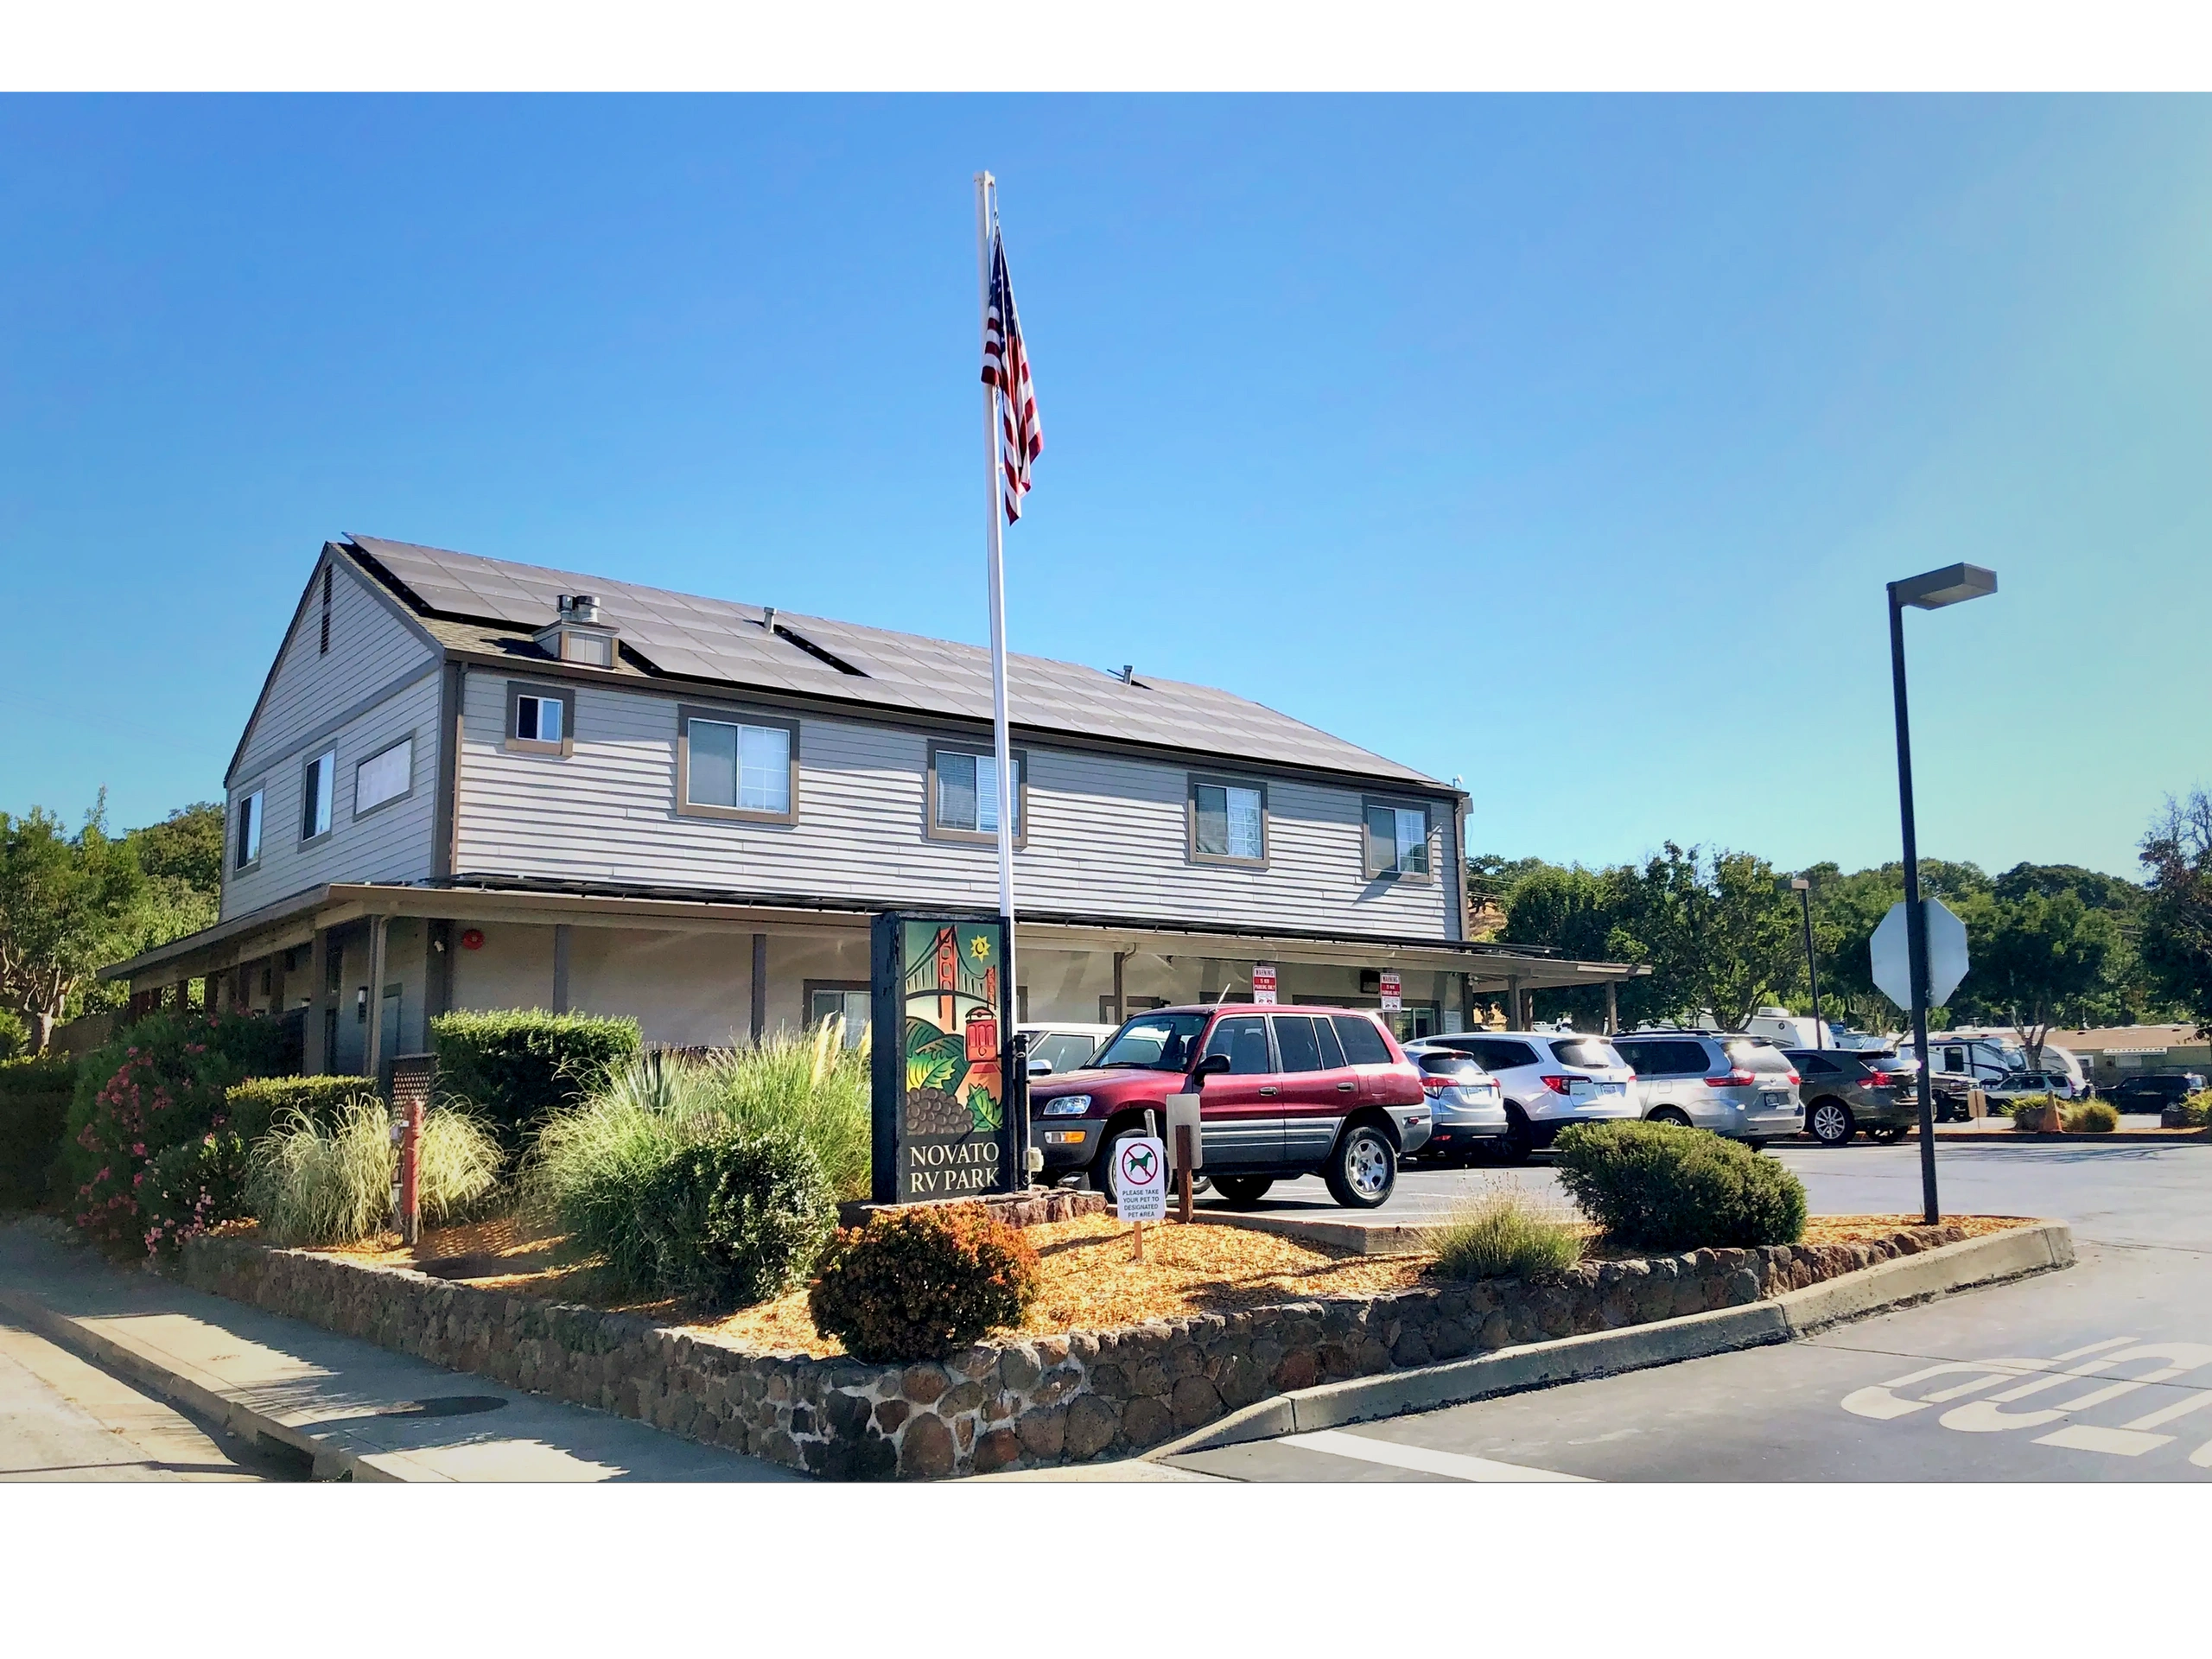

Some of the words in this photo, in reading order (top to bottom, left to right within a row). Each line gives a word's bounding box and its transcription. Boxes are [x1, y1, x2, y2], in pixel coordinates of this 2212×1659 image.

[910, 1142, 1000, 1166] NOVATO
[910, 1171, 940, 1192] RV
[944, 1167, 1001, 1191] PARK
[1840, 1337, 2212, 1468] TOP
